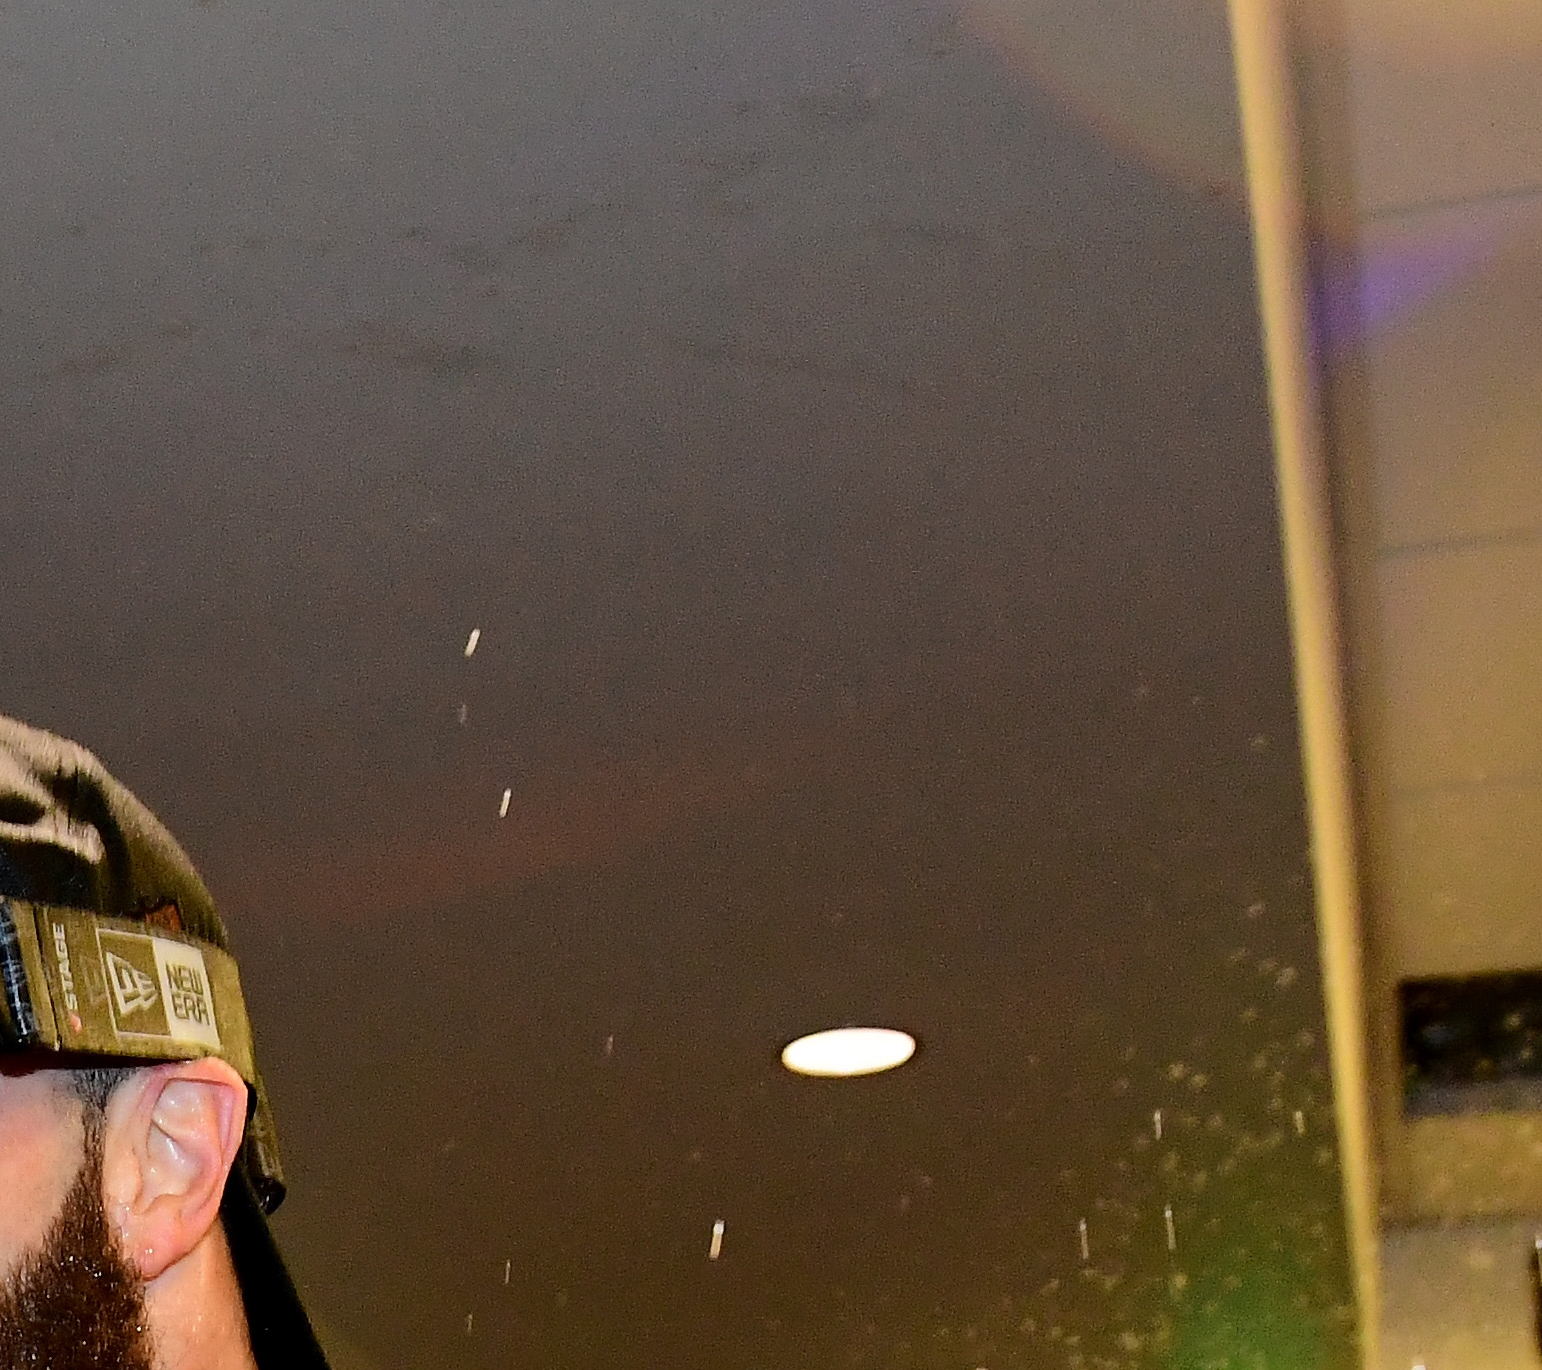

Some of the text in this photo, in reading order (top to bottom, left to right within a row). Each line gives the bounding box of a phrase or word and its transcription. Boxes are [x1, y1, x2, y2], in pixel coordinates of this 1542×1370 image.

[53, 922, 78, 1011] STAGE
[166, 962, 204, 995] NEW
[173, 992, 211, 1026] ERA
